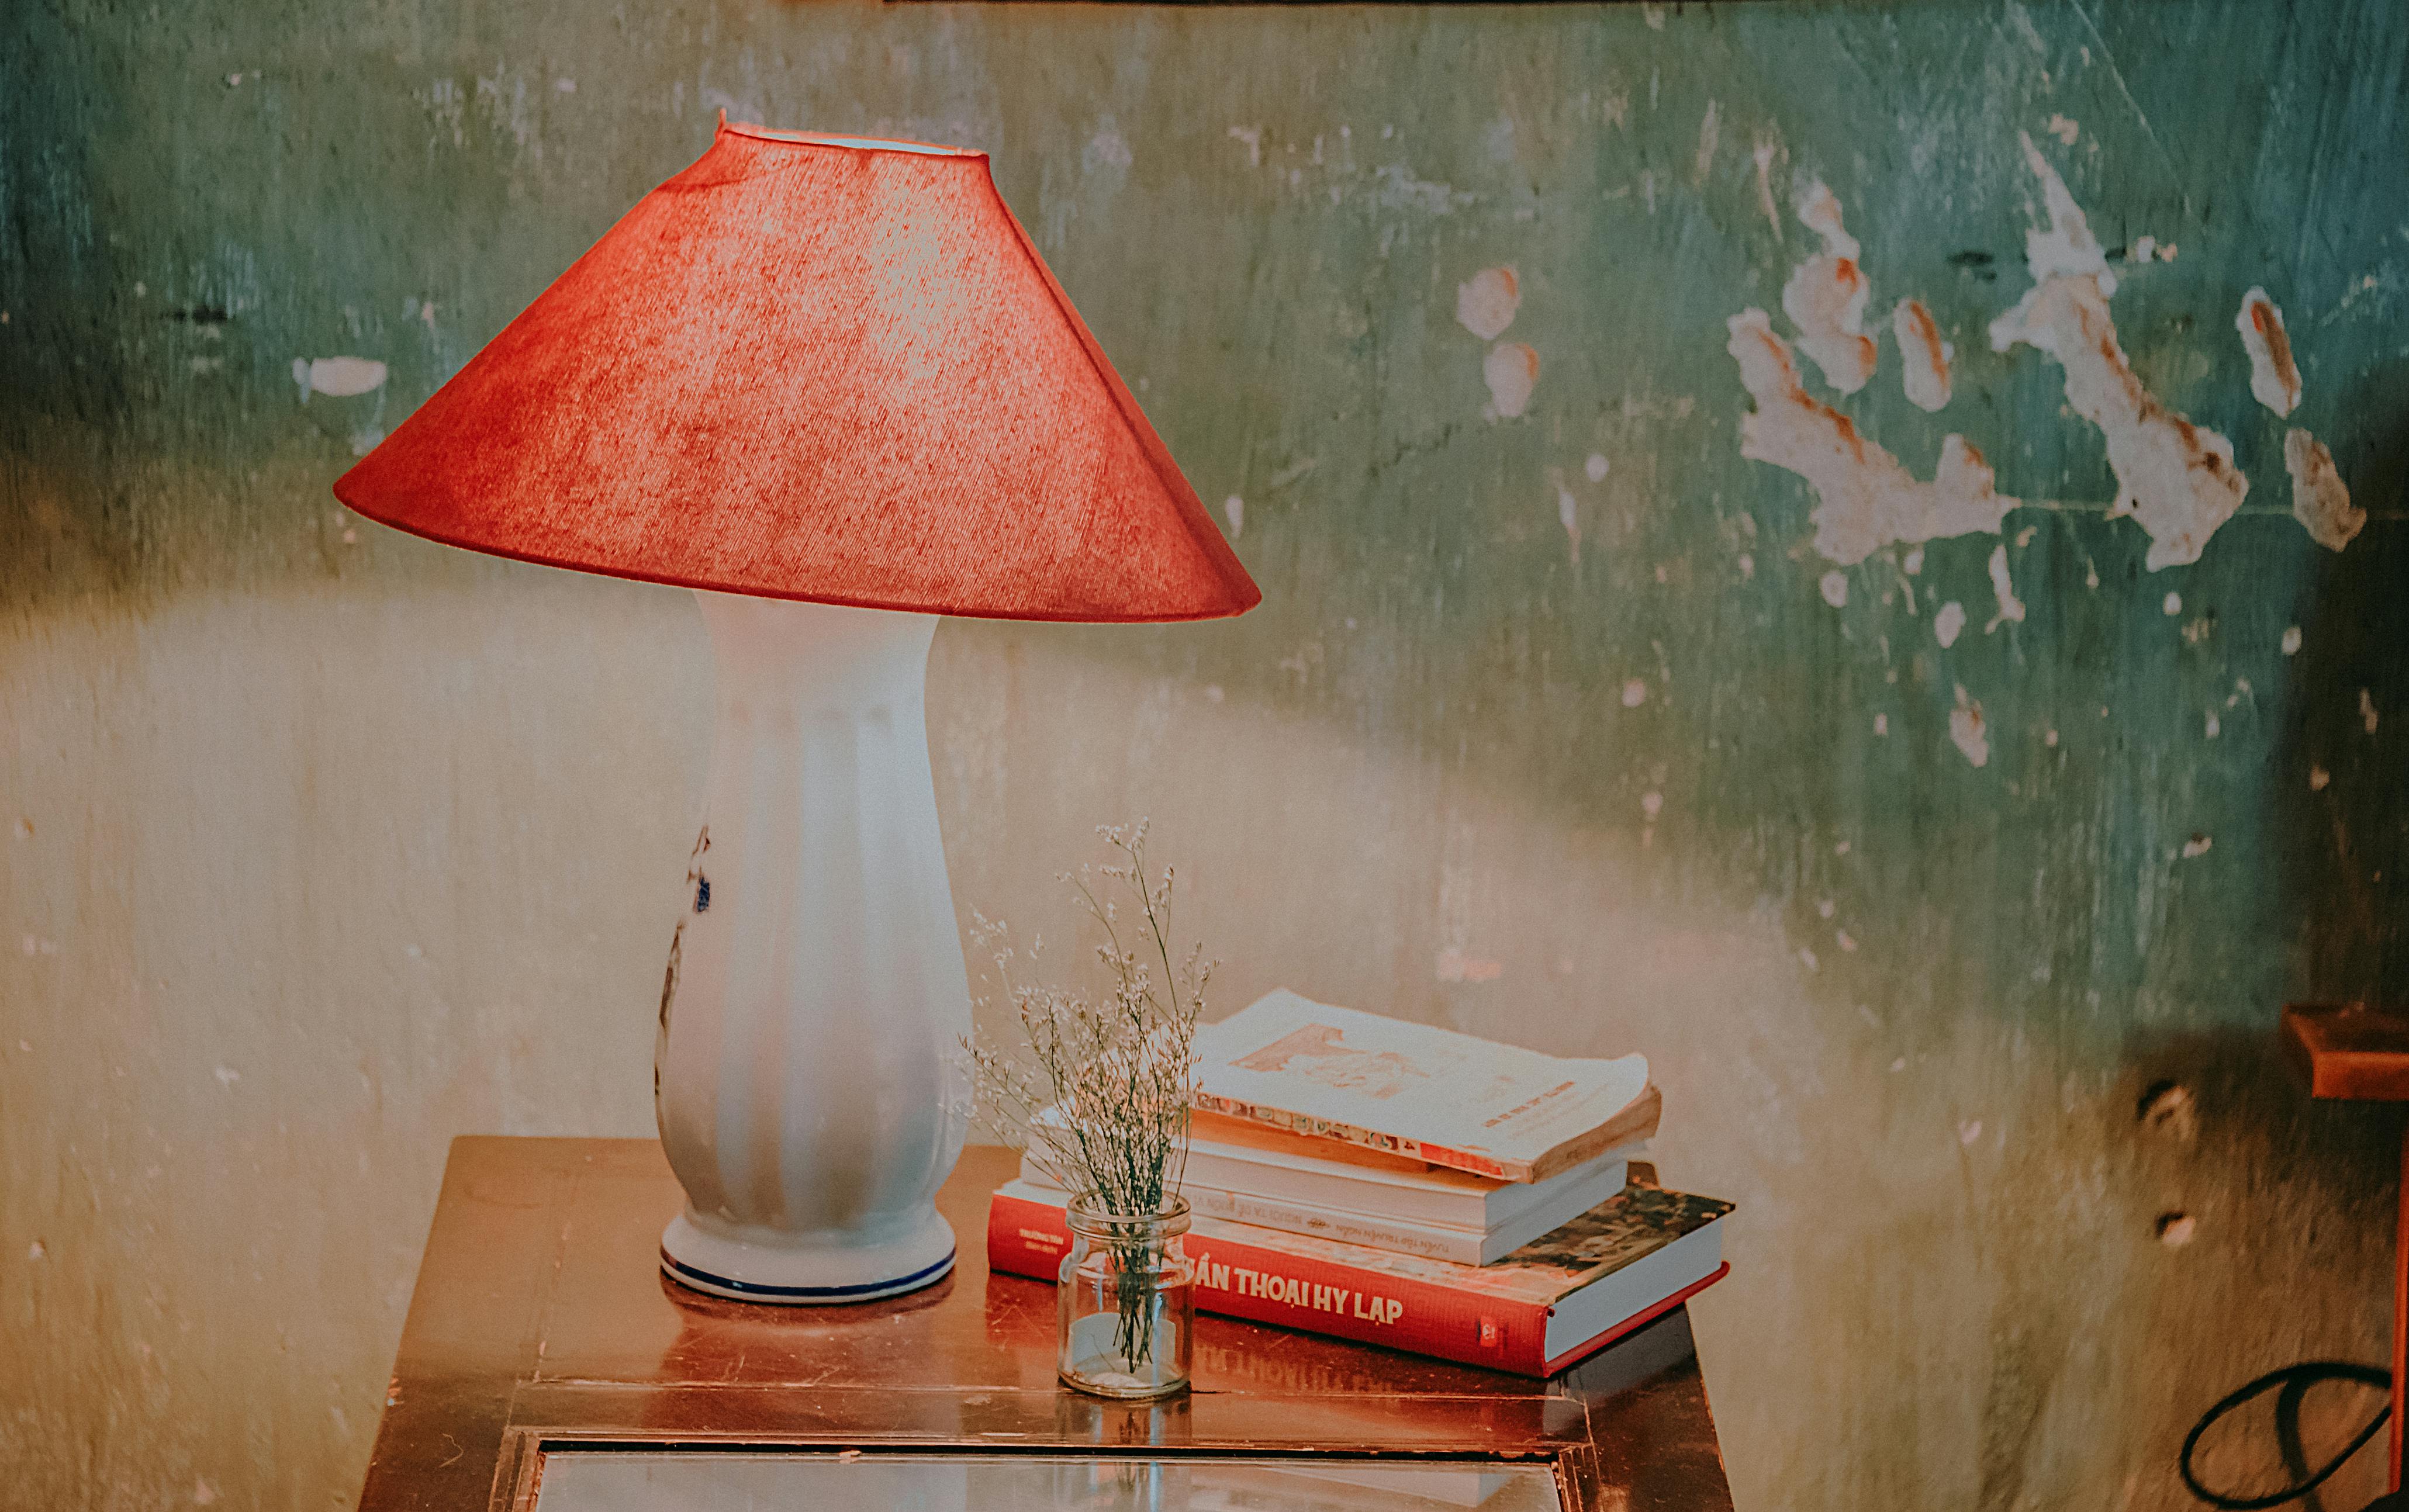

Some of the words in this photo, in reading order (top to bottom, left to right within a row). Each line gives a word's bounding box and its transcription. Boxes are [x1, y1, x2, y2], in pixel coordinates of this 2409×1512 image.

[1234, 1267, 1309, 1309] THOẠI
[1314, 1285, 1349, 1315] HY
[1354, 1292, 1404, 1327] LẠP
